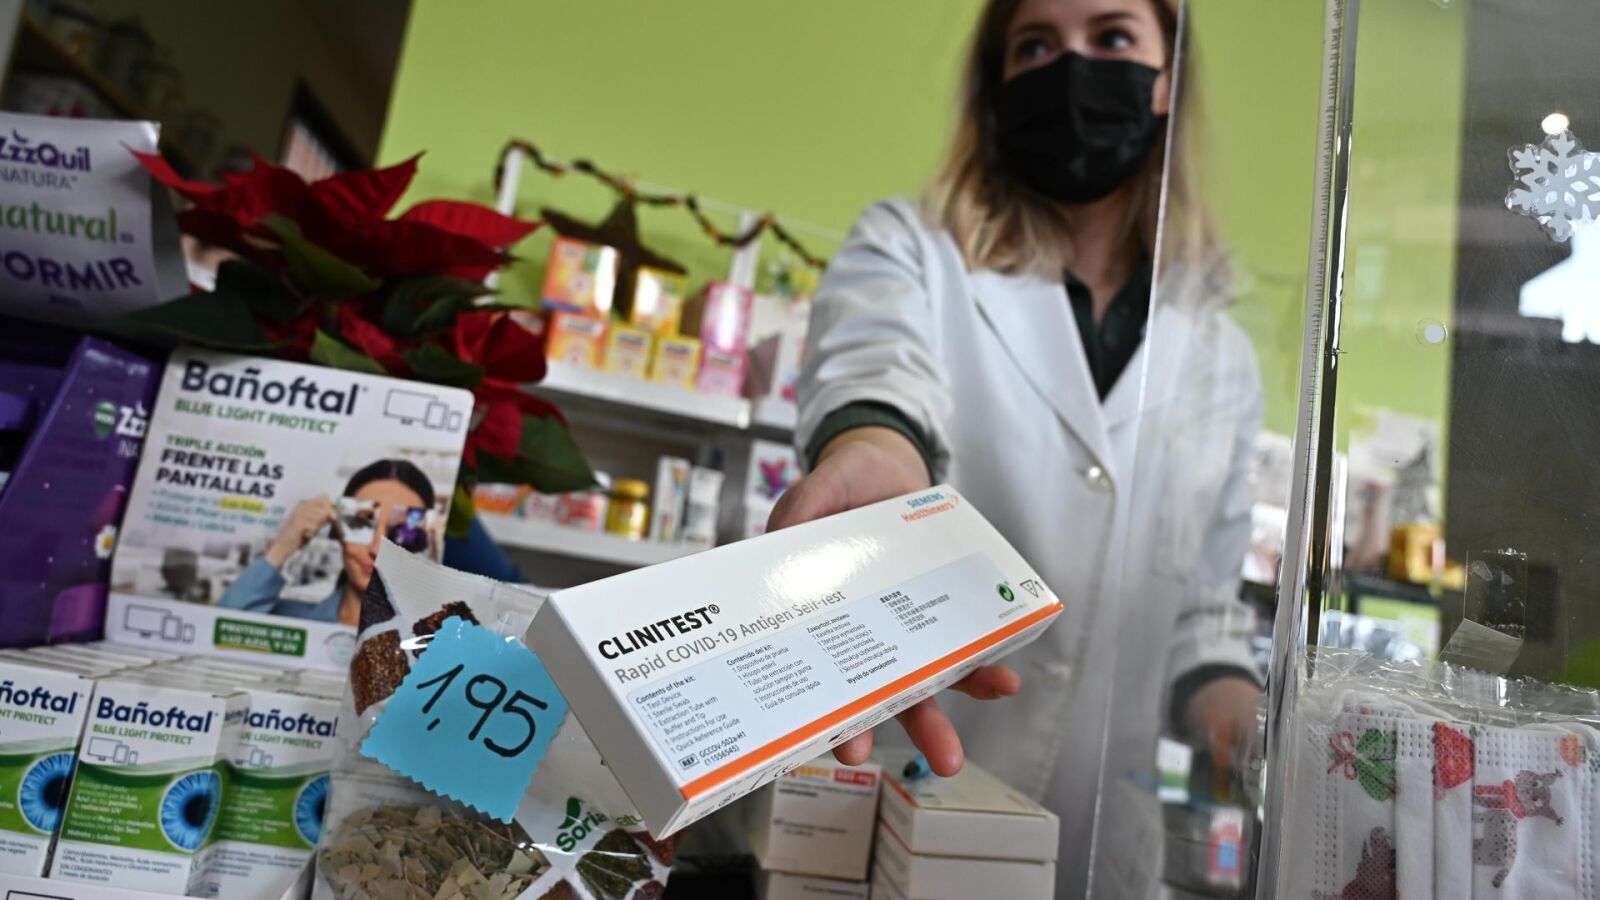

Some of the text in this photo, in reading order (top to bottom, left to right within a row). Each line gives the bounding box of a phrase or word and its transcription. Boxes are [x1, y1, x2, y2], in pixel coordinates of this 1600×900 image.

[0, 202, 117, 244] atural
[0, 251, 142, 290] ORMIR
[181, 359, 360, 415] Bañoftal
[175, 399, 339, 435] BLUE LIGHT PROTECT
[167, 434, 213, 451] TRIPLE
[161, 448, 285, 481] FRENTE LAS
[156, 467, 276, 499] PANTALLAS
[614, 654, 666, 684] Rapid
[666, 628, 738, 662] COVID-19
[740, 611, 794, 637] Antigen
[726, 652, 755, 666] Contenido
[417, 663, 548, 758] 1,95
[636, 688, 666, 704] Contents
[14, 711, 56, 726] PROTECT
[97, 696, 213, 733] Bañoftal
[93, 723, 193, 745] BLUE LIGHT PROTECT
